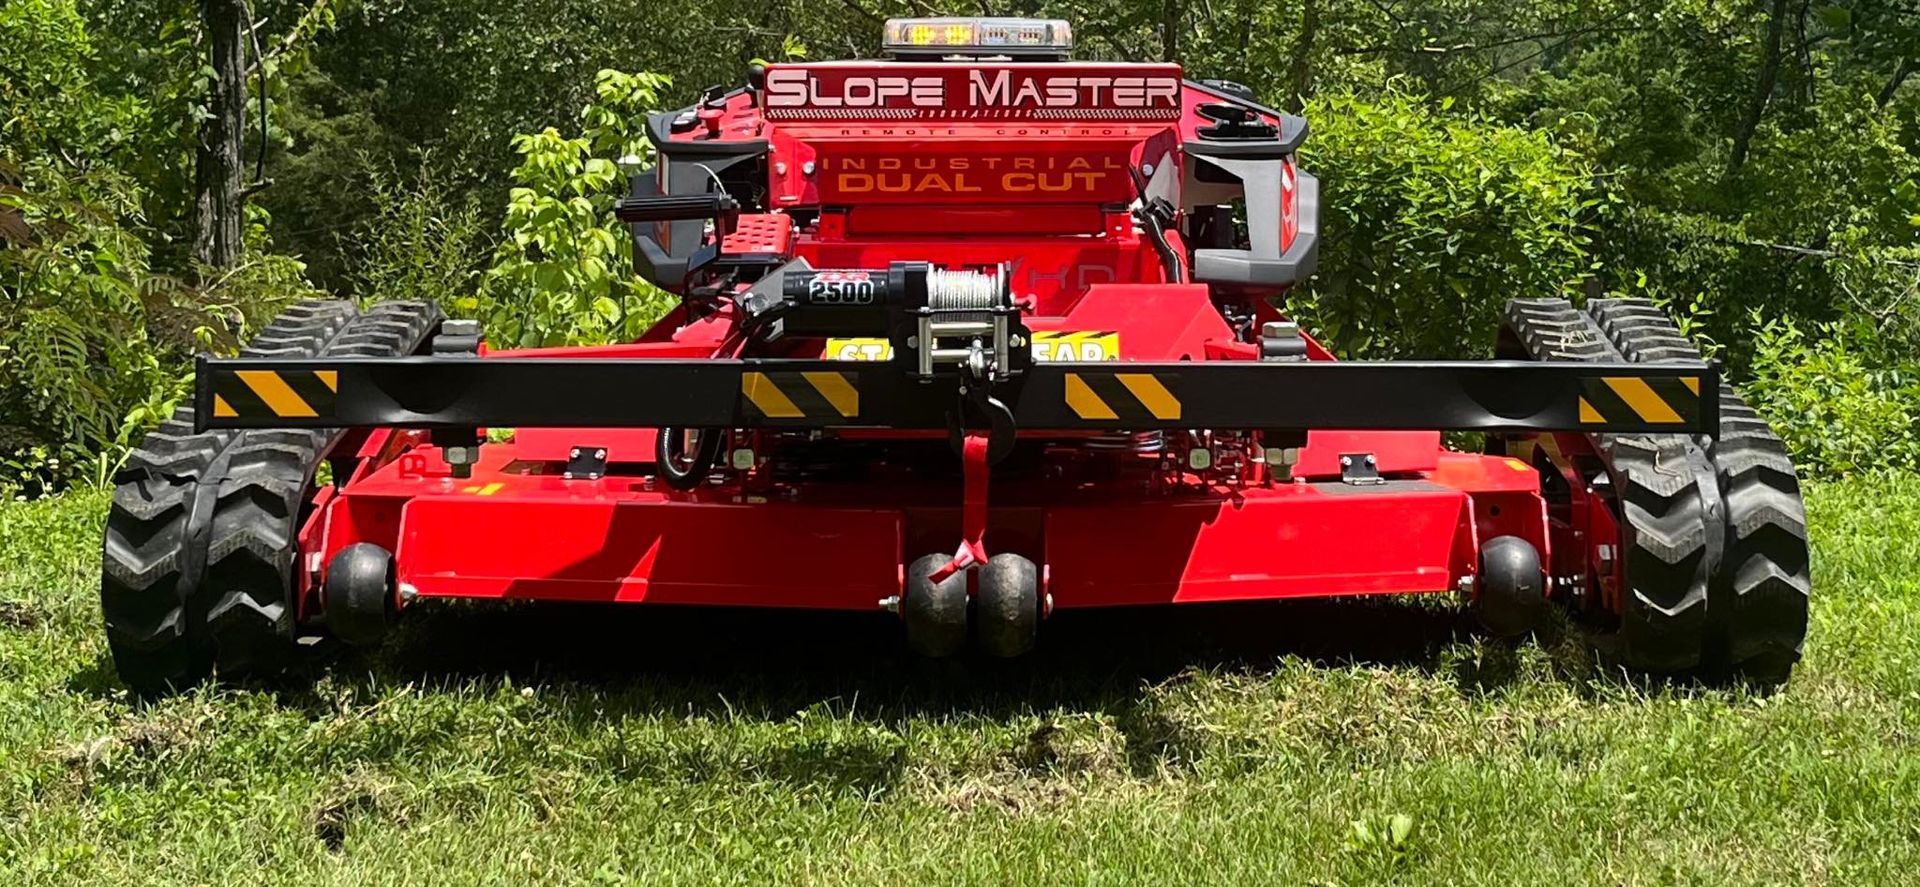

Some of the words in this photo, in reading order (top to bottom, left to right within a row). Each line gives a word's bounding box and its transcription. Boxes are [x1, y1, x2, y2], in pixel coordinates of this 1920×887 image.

[767, 69, 944, 106] SLOPE
[969, 69, 1179, 107] MASTER
[823, 157, 1121, 169] INDUSTRIAL
[838, 173, 982, 192] DUAL
[1001, 172, 1106, 191] CUT
[810, 281, 873, 303] 2500
